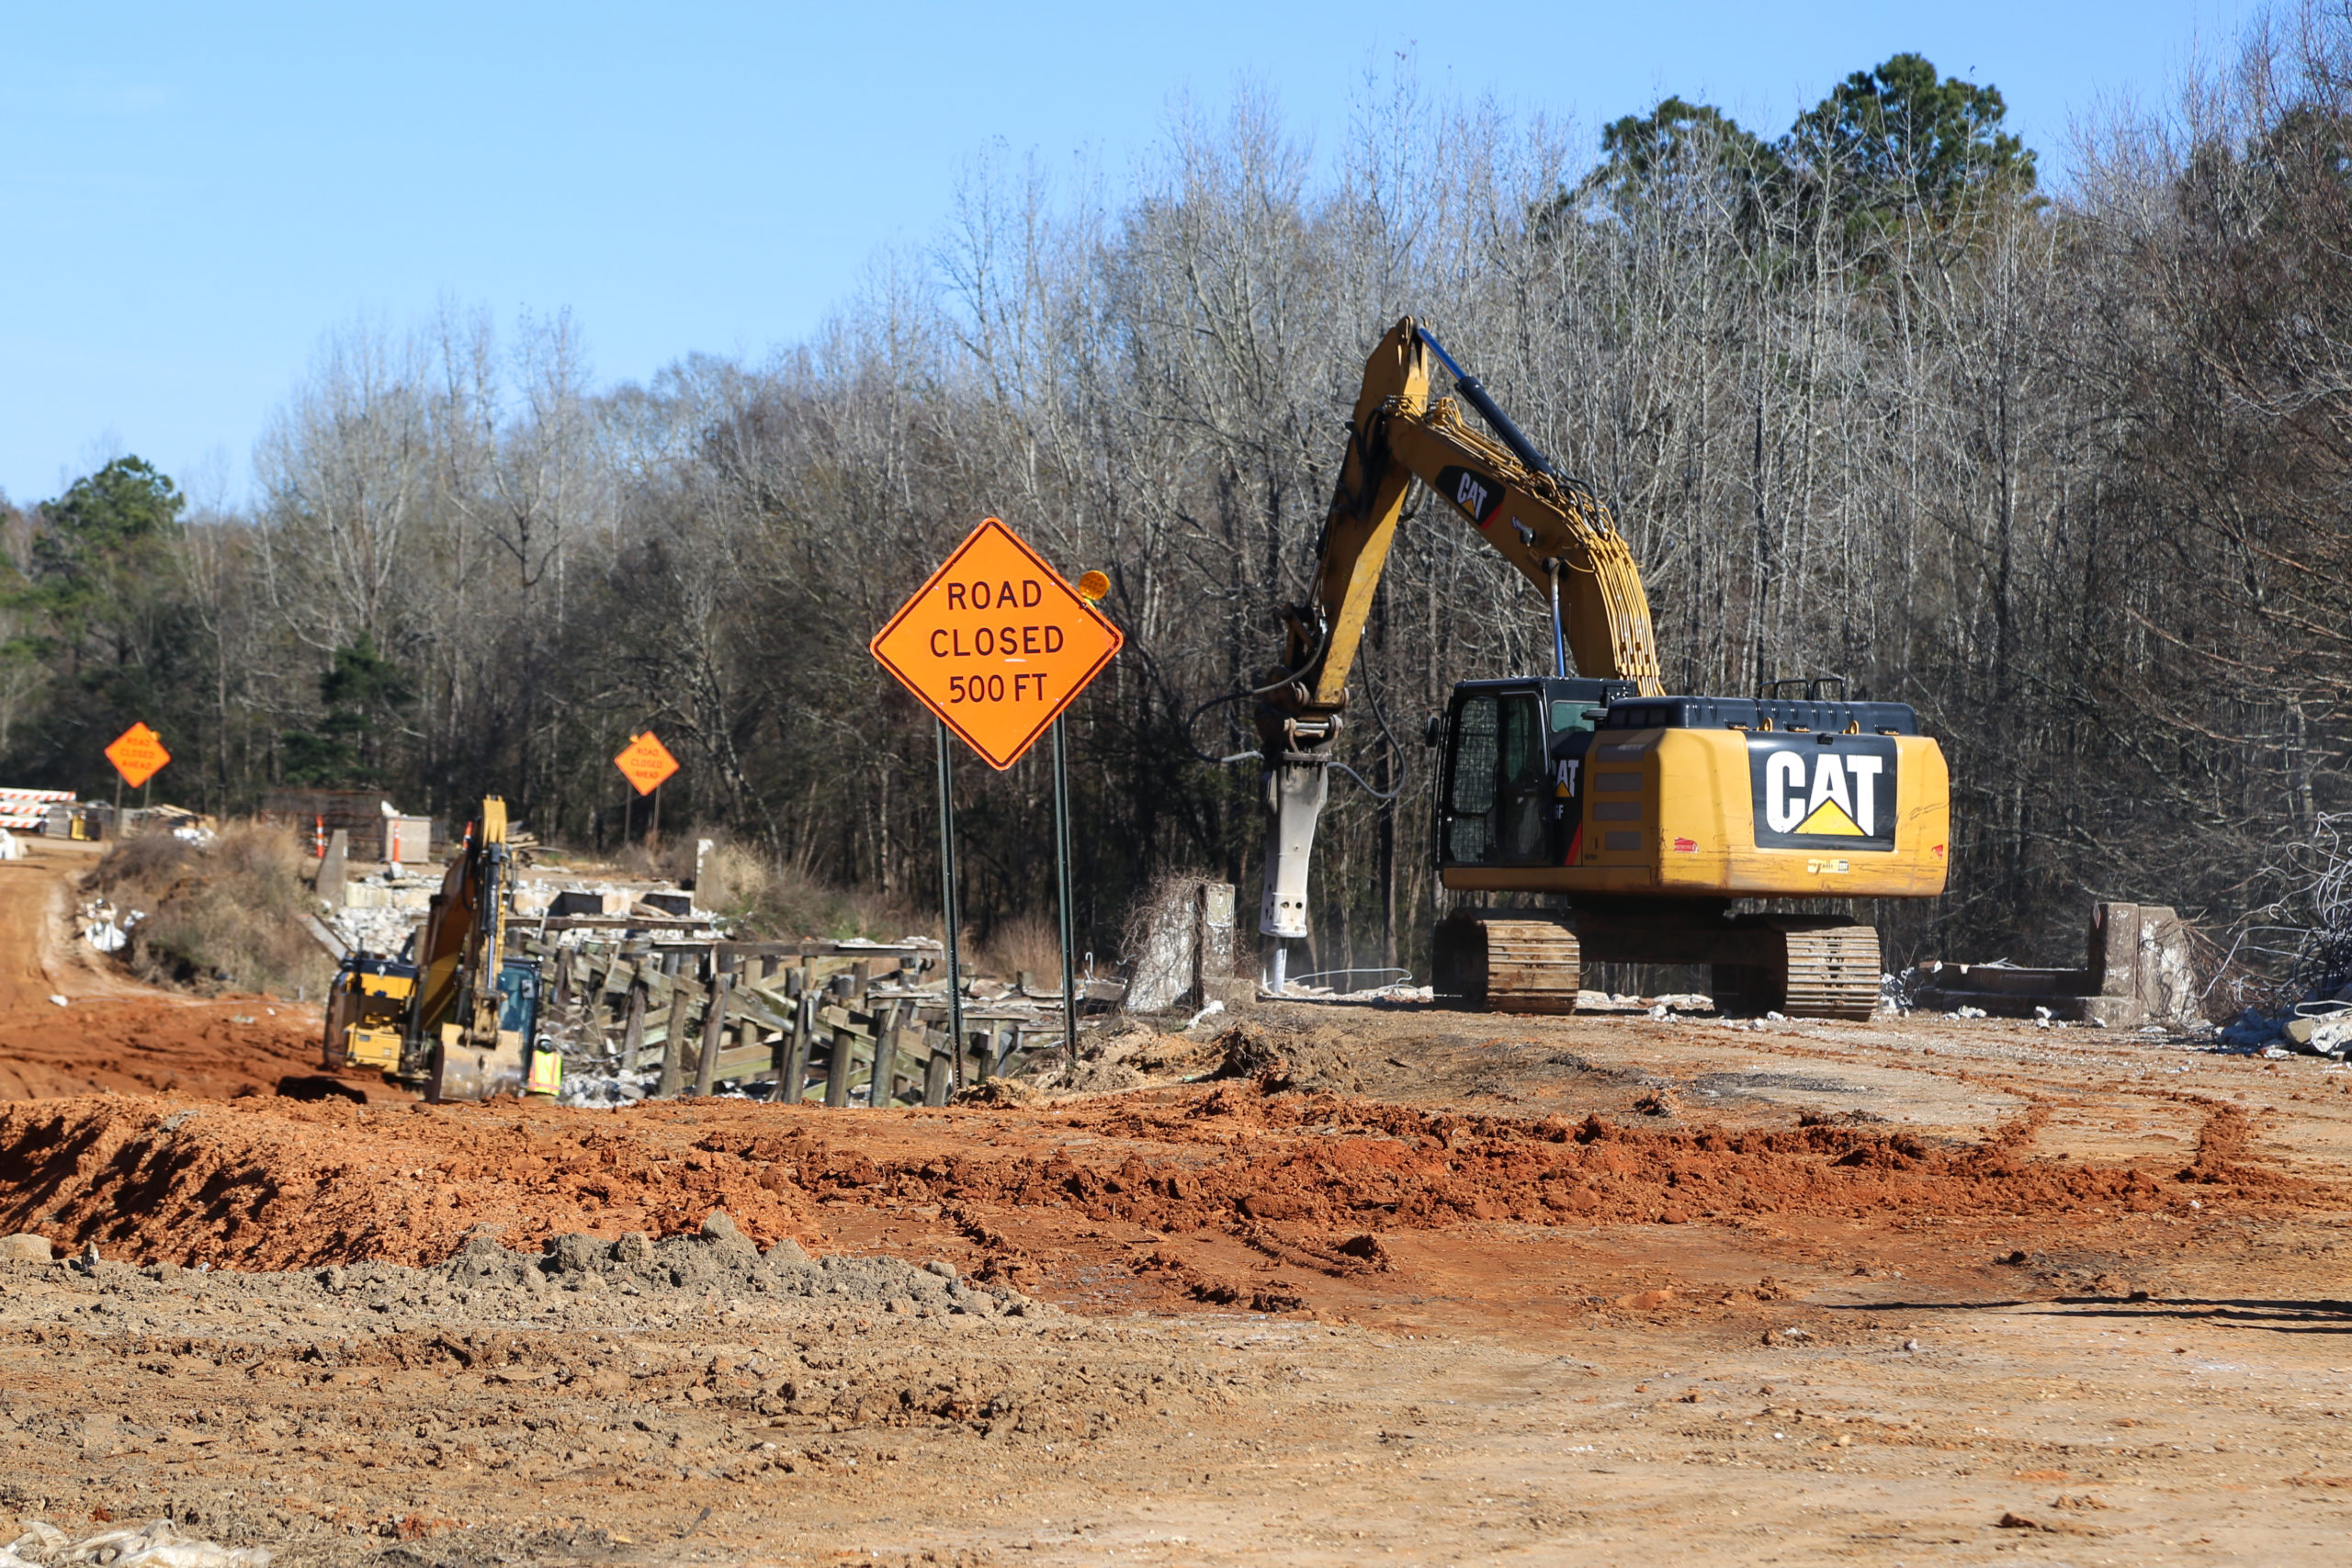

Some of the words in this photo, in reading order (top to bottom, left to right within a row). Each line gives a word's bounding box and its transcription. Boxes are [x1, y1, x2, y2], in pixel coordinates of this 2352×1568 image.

[1457, 472, 1487, 519] CAT
[947, 580, 1042, 610] ROAD
[930, 626, 1064, 658] CLOSED
[949, 674, 1004, 704] 500
[1014, 673, 1047, 702] FT
[630, 758, 662, 769] CLOSED
[636, 747, 660, 757] ROAD
[636, 771, 659, 780] AHEAD
[1766, 750, 1883, 837] CAT
